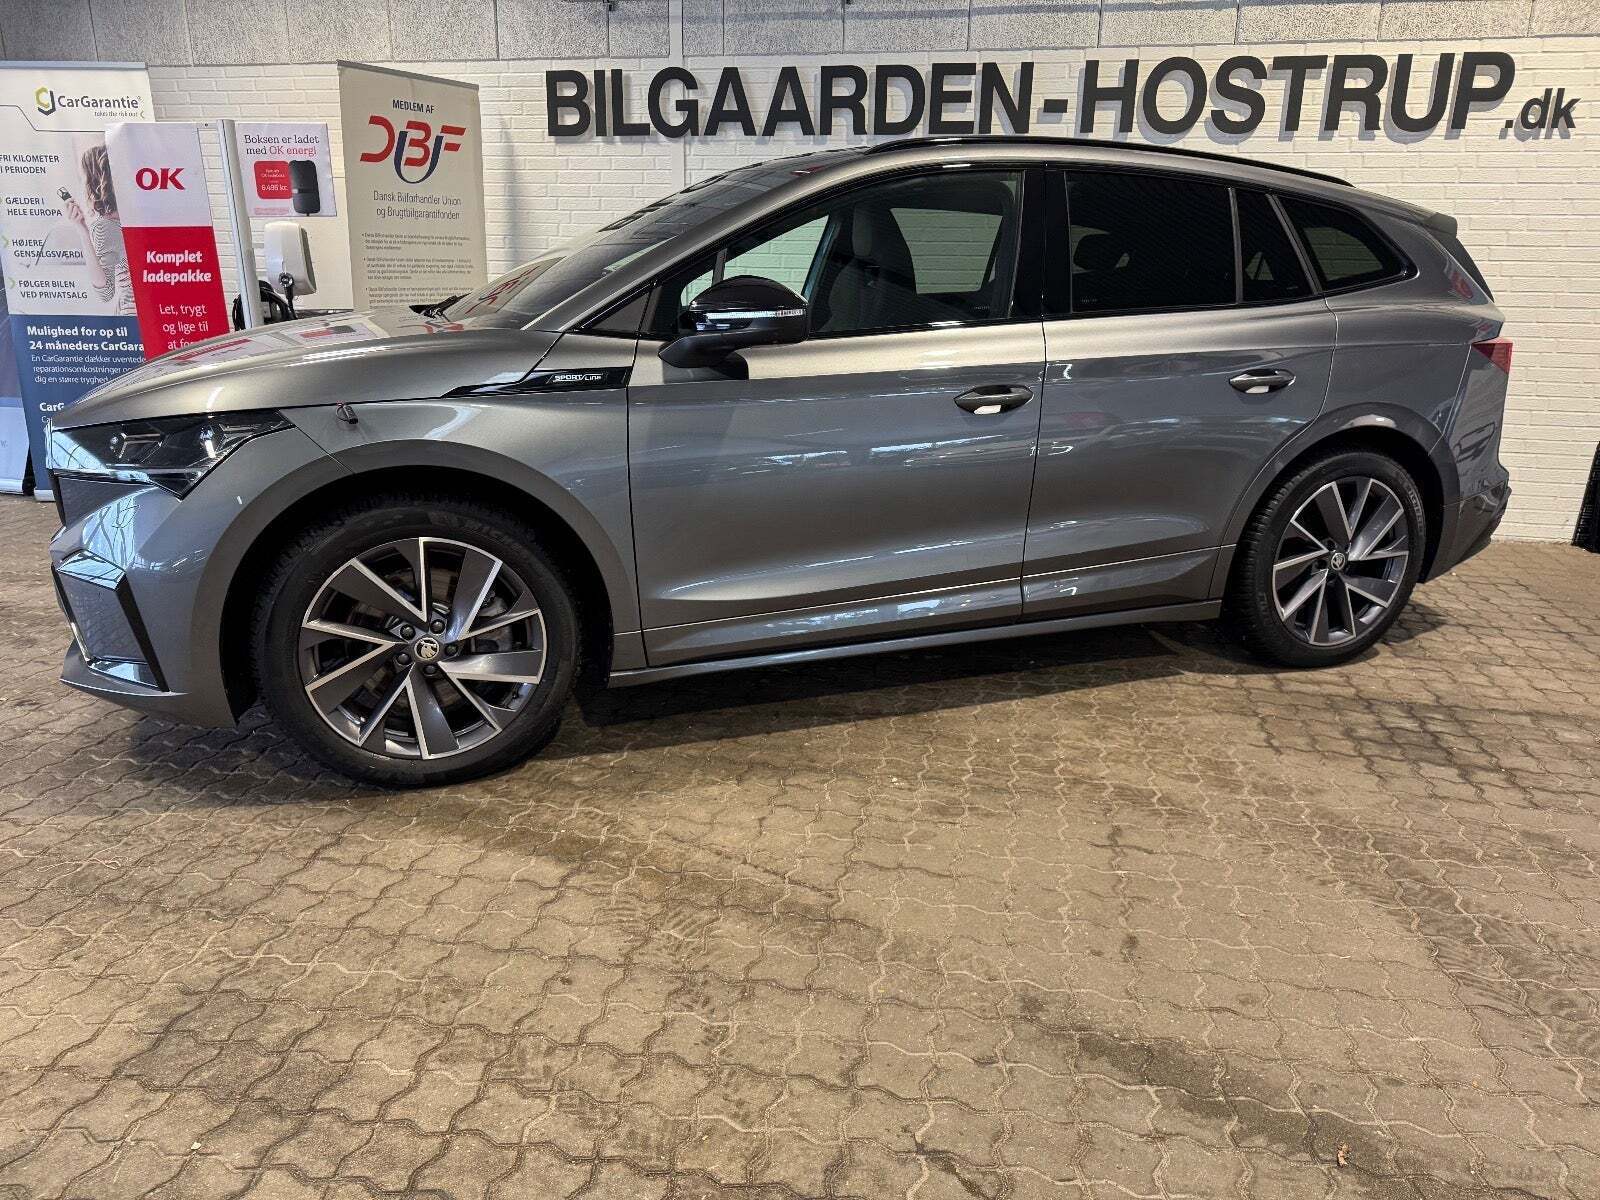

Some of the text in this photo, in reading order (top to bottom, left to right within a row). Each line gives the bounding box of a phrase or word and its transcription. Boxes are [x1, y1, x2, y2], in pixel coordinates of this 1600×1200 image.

[546, 52, 1582, 137] BILGAARDEN-HOSTRUP.dk
[58, 95, 139, 108] CarGarantie
[392, 99, 435, 114] MEDLEM AF
[244, 134, 320, 144] Boksen er ladet
[246, 145, 317, 157] med OK energi
[12, 154, 60, 163] KILOMETER
[4, 165, 46, 174] PERIODEN
[135, 167, 185, 190] OK
[5, 197, 41, 205] GÆLDER
[373, 190, 395, 202] Dansk
[7, 208, 63, 217] HELE EUROPA
[376, 207, 386, 218] og
[12, 239, 43, 247] HØJERE
[13, 250, 84, 258] GENSALGSVÆRDI
[146, 251, 203, 267] Komplet
[142, 269, 212, 285] ladepakke
[18, 280, 76, 288] FØLGER BILEN
[20, 291, 88, 299] VED PRIVATSALG
[159, 304, 207, 317] Let, trygt
[27, 326, 128, 338] Mulighed for op til
[162, 321, 209, 335] og lige til
[29, 340, 145, 351] 24 måneders CarGara
[84, 354, 111, 362] dækker
[33, 365, 121, 375] reparationsomkostninger
[35, 376, 47, 385] dig
